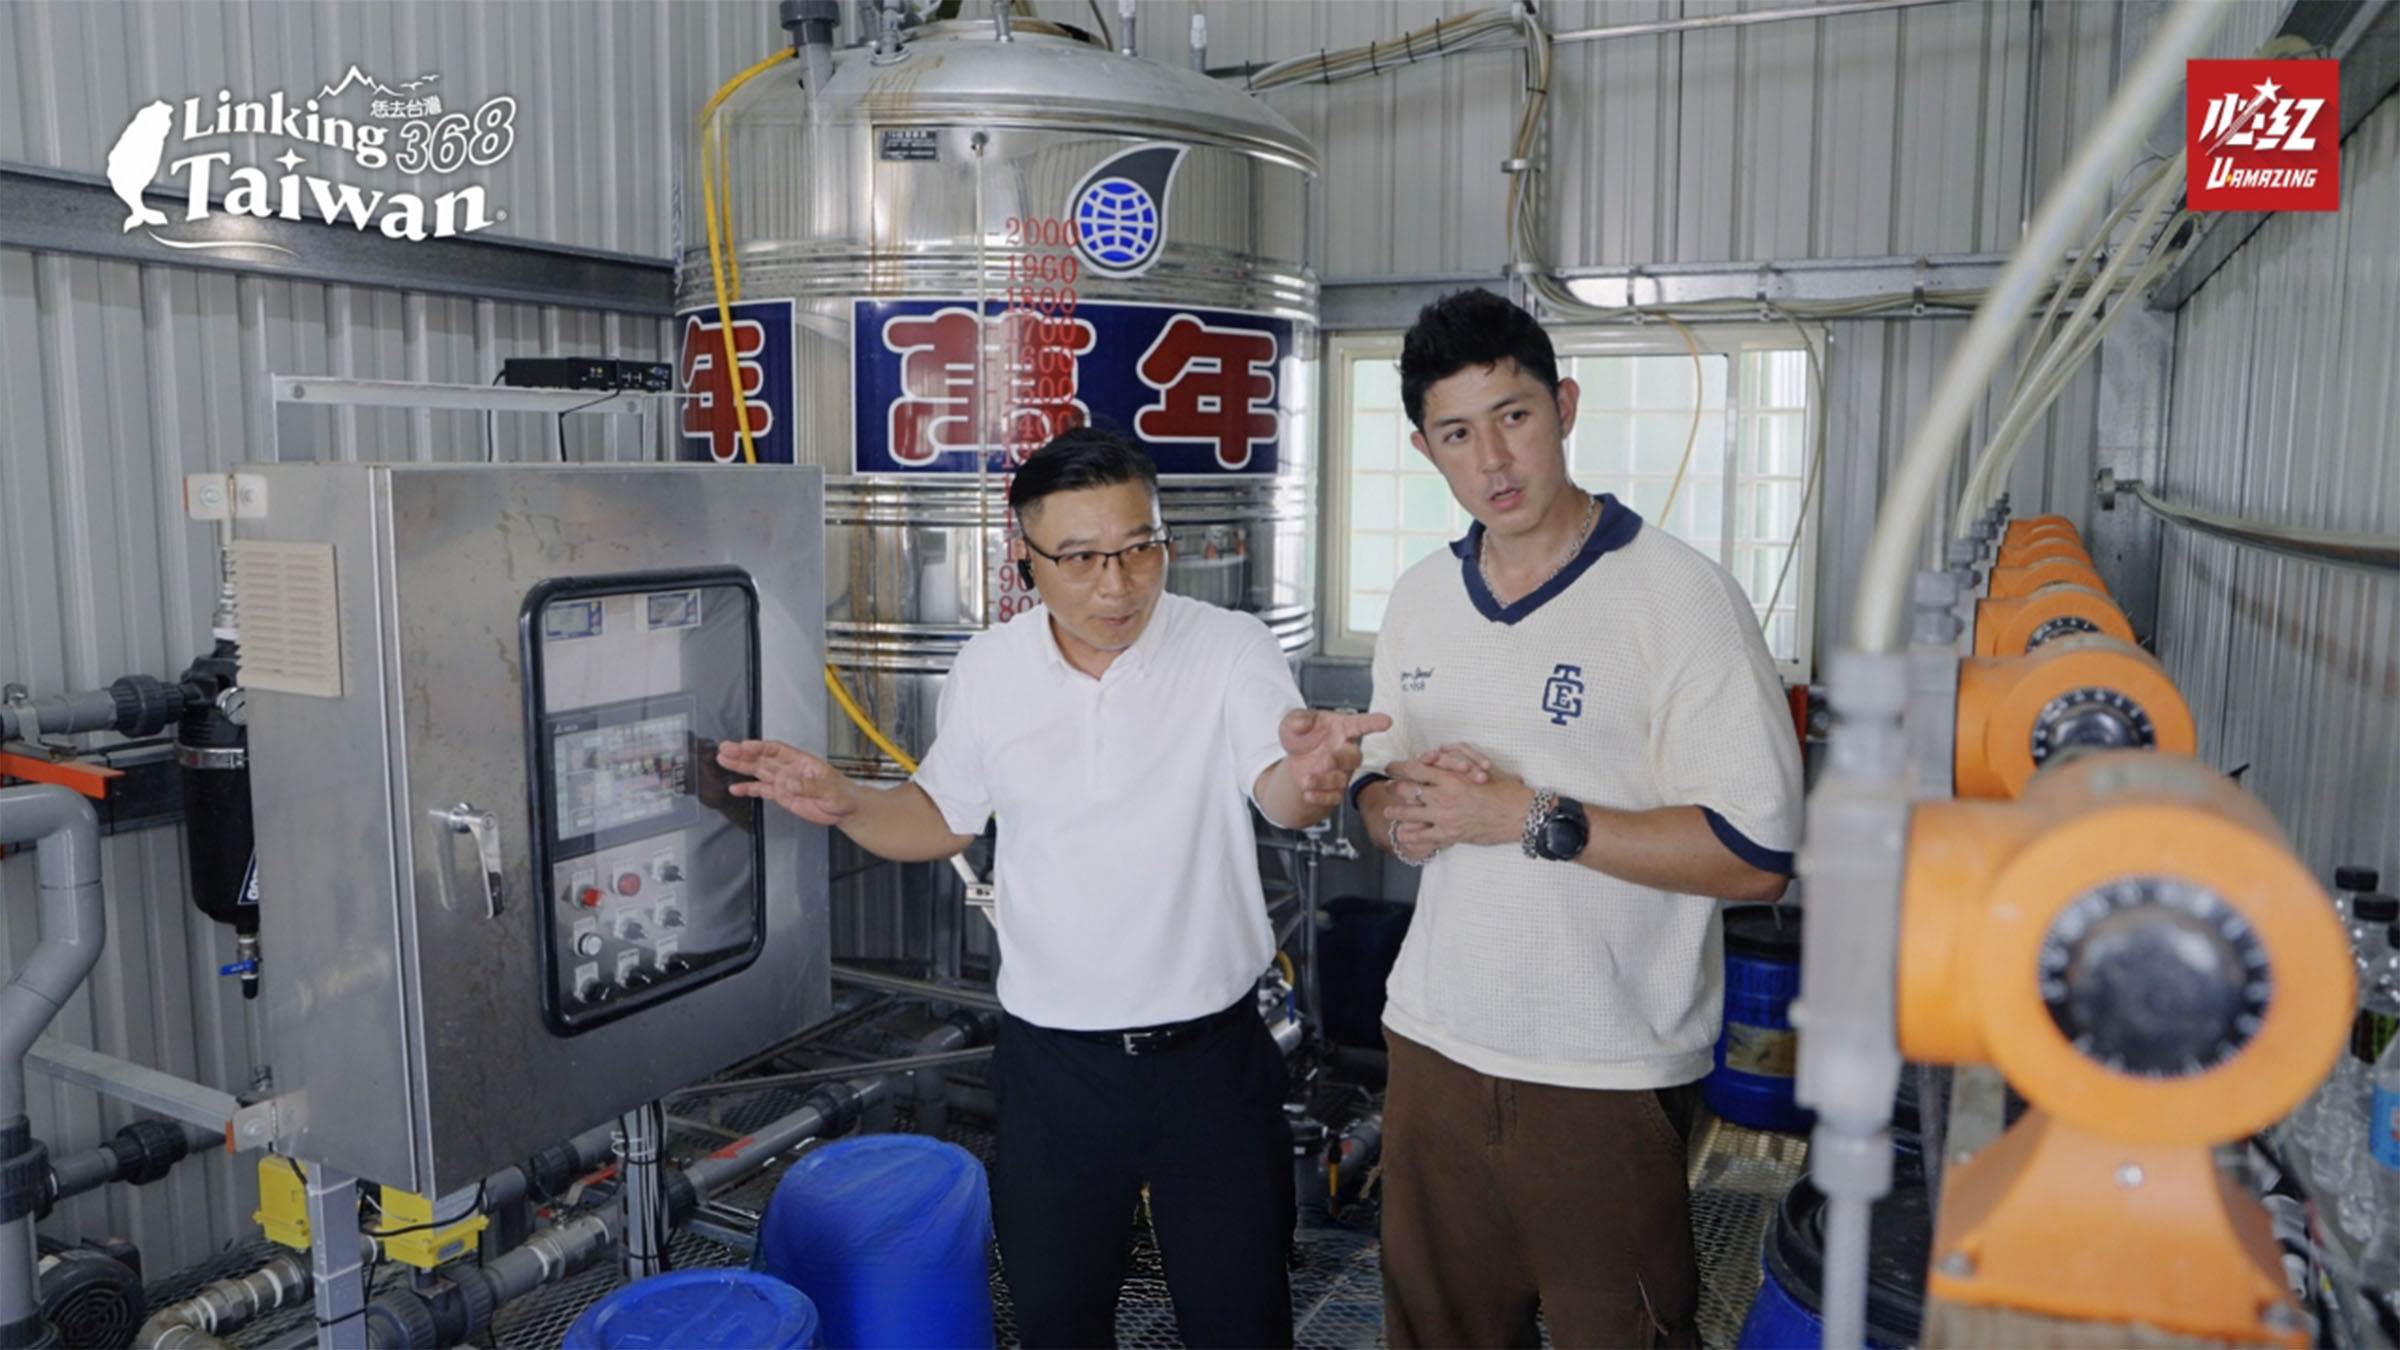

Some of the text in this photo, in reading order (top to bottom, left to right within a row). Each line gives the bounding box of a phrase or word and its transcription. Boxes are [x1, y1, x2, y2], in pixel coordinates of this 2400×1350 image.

[1006, 217, 1079, 247] 2000
[1006, 286, 1077, 315] 1800
[1006, 315, 1076, 344] 1700
[1005, 346, 1075, 374] 1600
